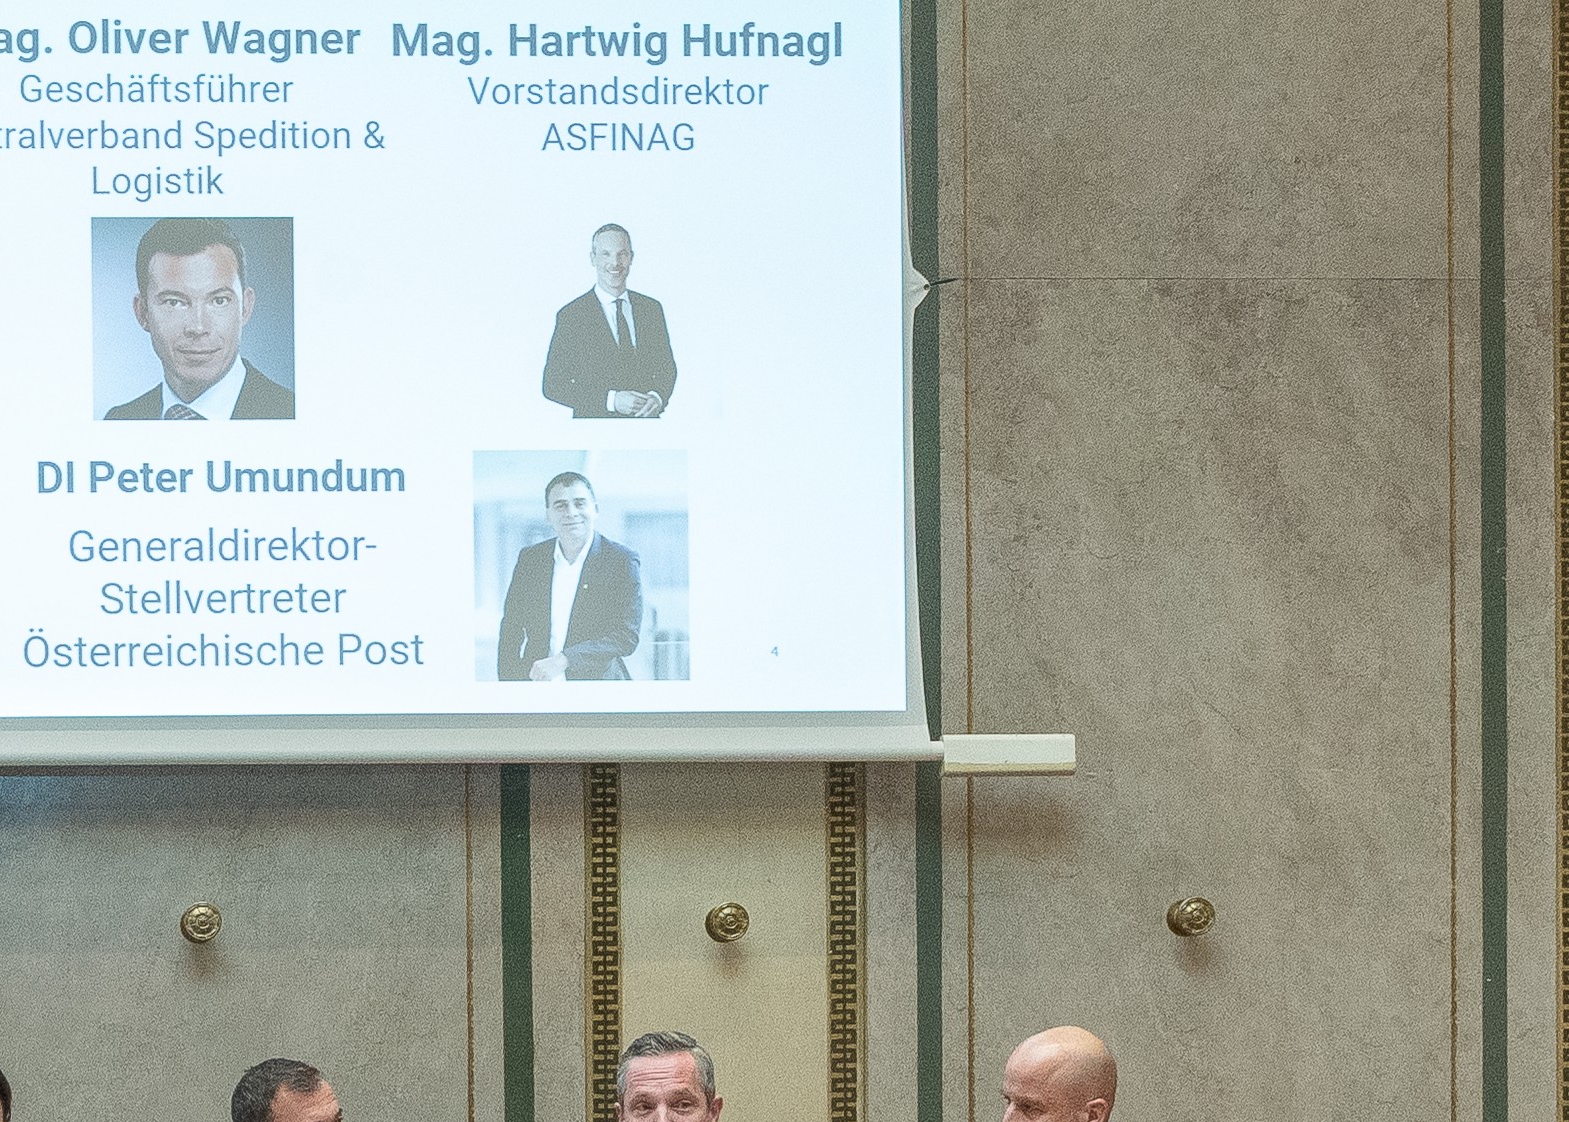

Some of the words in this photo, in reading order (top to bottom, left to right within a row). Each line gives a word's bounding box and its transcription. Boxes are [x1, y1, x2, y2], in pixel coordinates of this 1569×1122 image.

[68, 18, 190, 55] Oliver
[202, 20, 362, 65] Wagner
[392, 22, 493, 67] Mag.
[509, 21, 668, 66] Hartwig
[682, 21, 843, 67] Hufnagl
[20, 73, 294, 104] Geschäftsführer
[467, 75, 769, 106] Vorstandsdirektor
[194, 119, 351, 158] Spedition
[363, 120, 385, 150] &
[541, 122, 695, 152] ASFINAG
[92, 165, 224, 203] Logistik
[37, 460, 75, 494] DI
[89, 460, 194, 494] Peter
[206, 458, 406, 493] Umundum
[69, 526, 377, 564] Generaldirektor-
[100, 580, 347, 615] Stellvertreter
[23, 628, 324, 668] Österreichische
[338, 633, 424, 667] Post
[771, 646, 779, 657] 4
